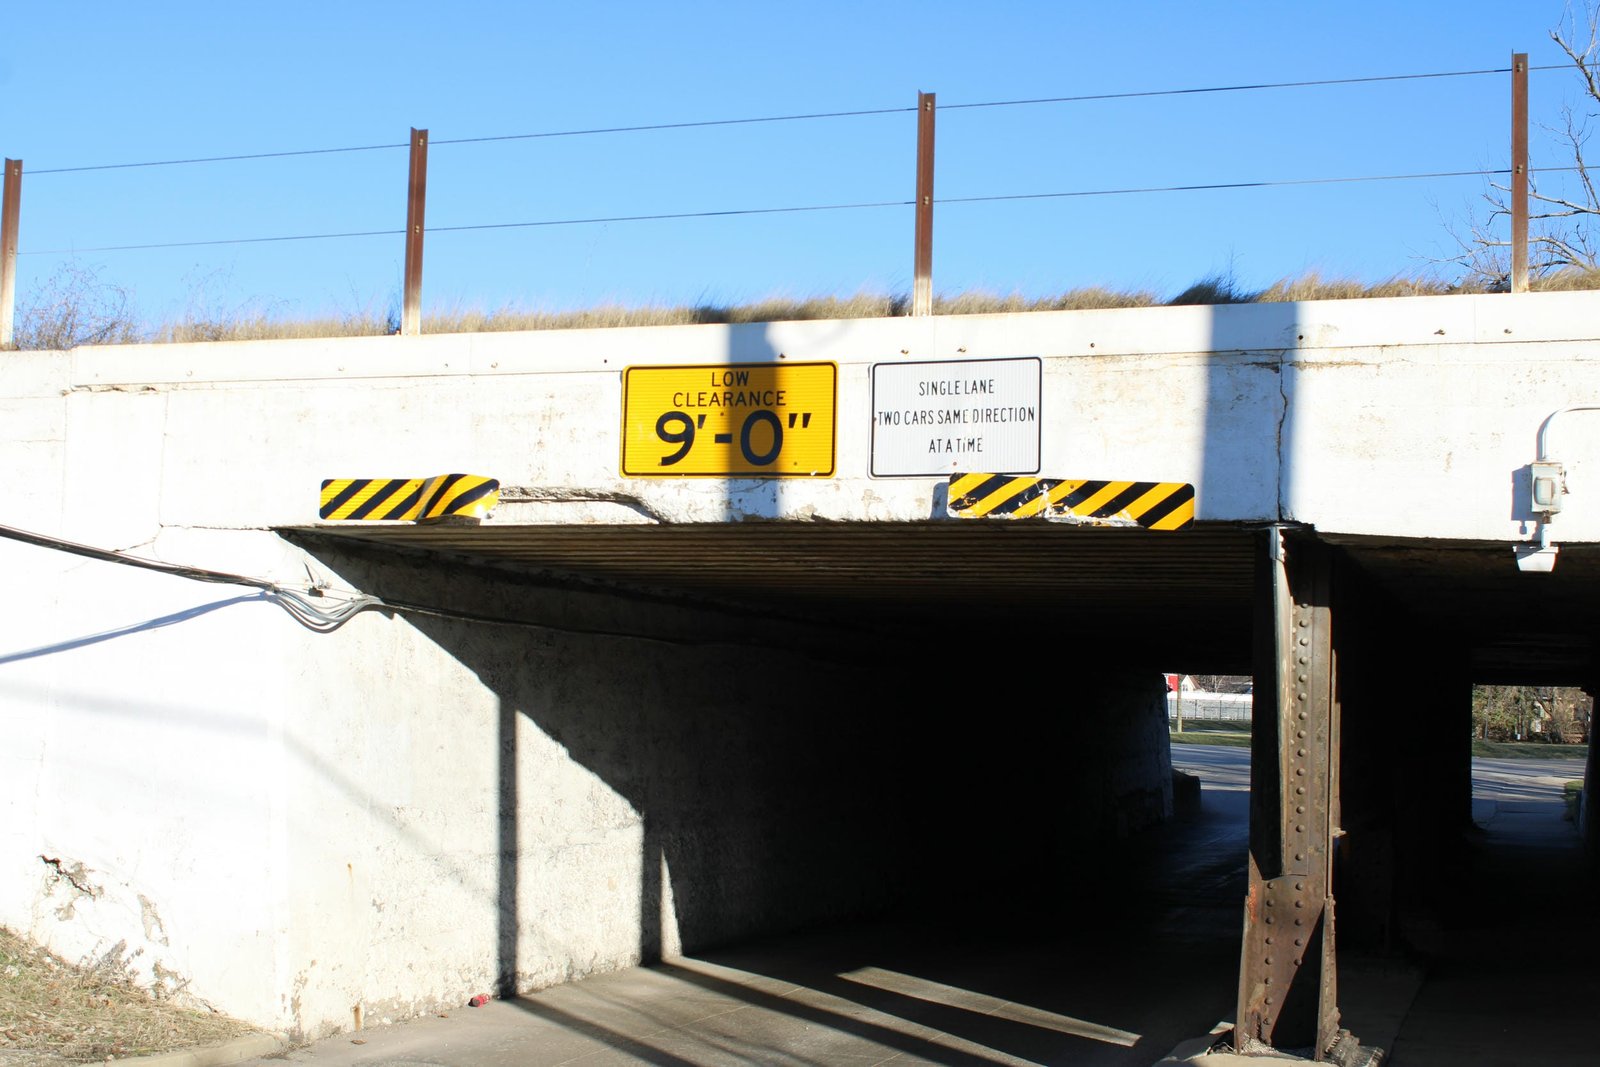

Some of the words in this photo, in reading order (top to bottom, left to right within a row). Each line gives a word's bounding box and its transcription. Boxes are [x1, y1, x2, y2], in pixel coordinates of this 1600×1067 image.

[711, 371, 749, 387] LOW
[919, 380, 960, 396] SINGLE
[964, 379, 995, 395] LANE
[673, 390, 787, 407] CLEARANCE
[878, 411, 900, 426] TWO
[904, 409, 934, 425] CARS
[937, 408, 969, 424] SAME
[973, 406, 1035, 423] DIRECTION
[928, 439, 942, 453] AT
[945, 438, 953, 453] A
[956, 437, 983, 453] TIME
